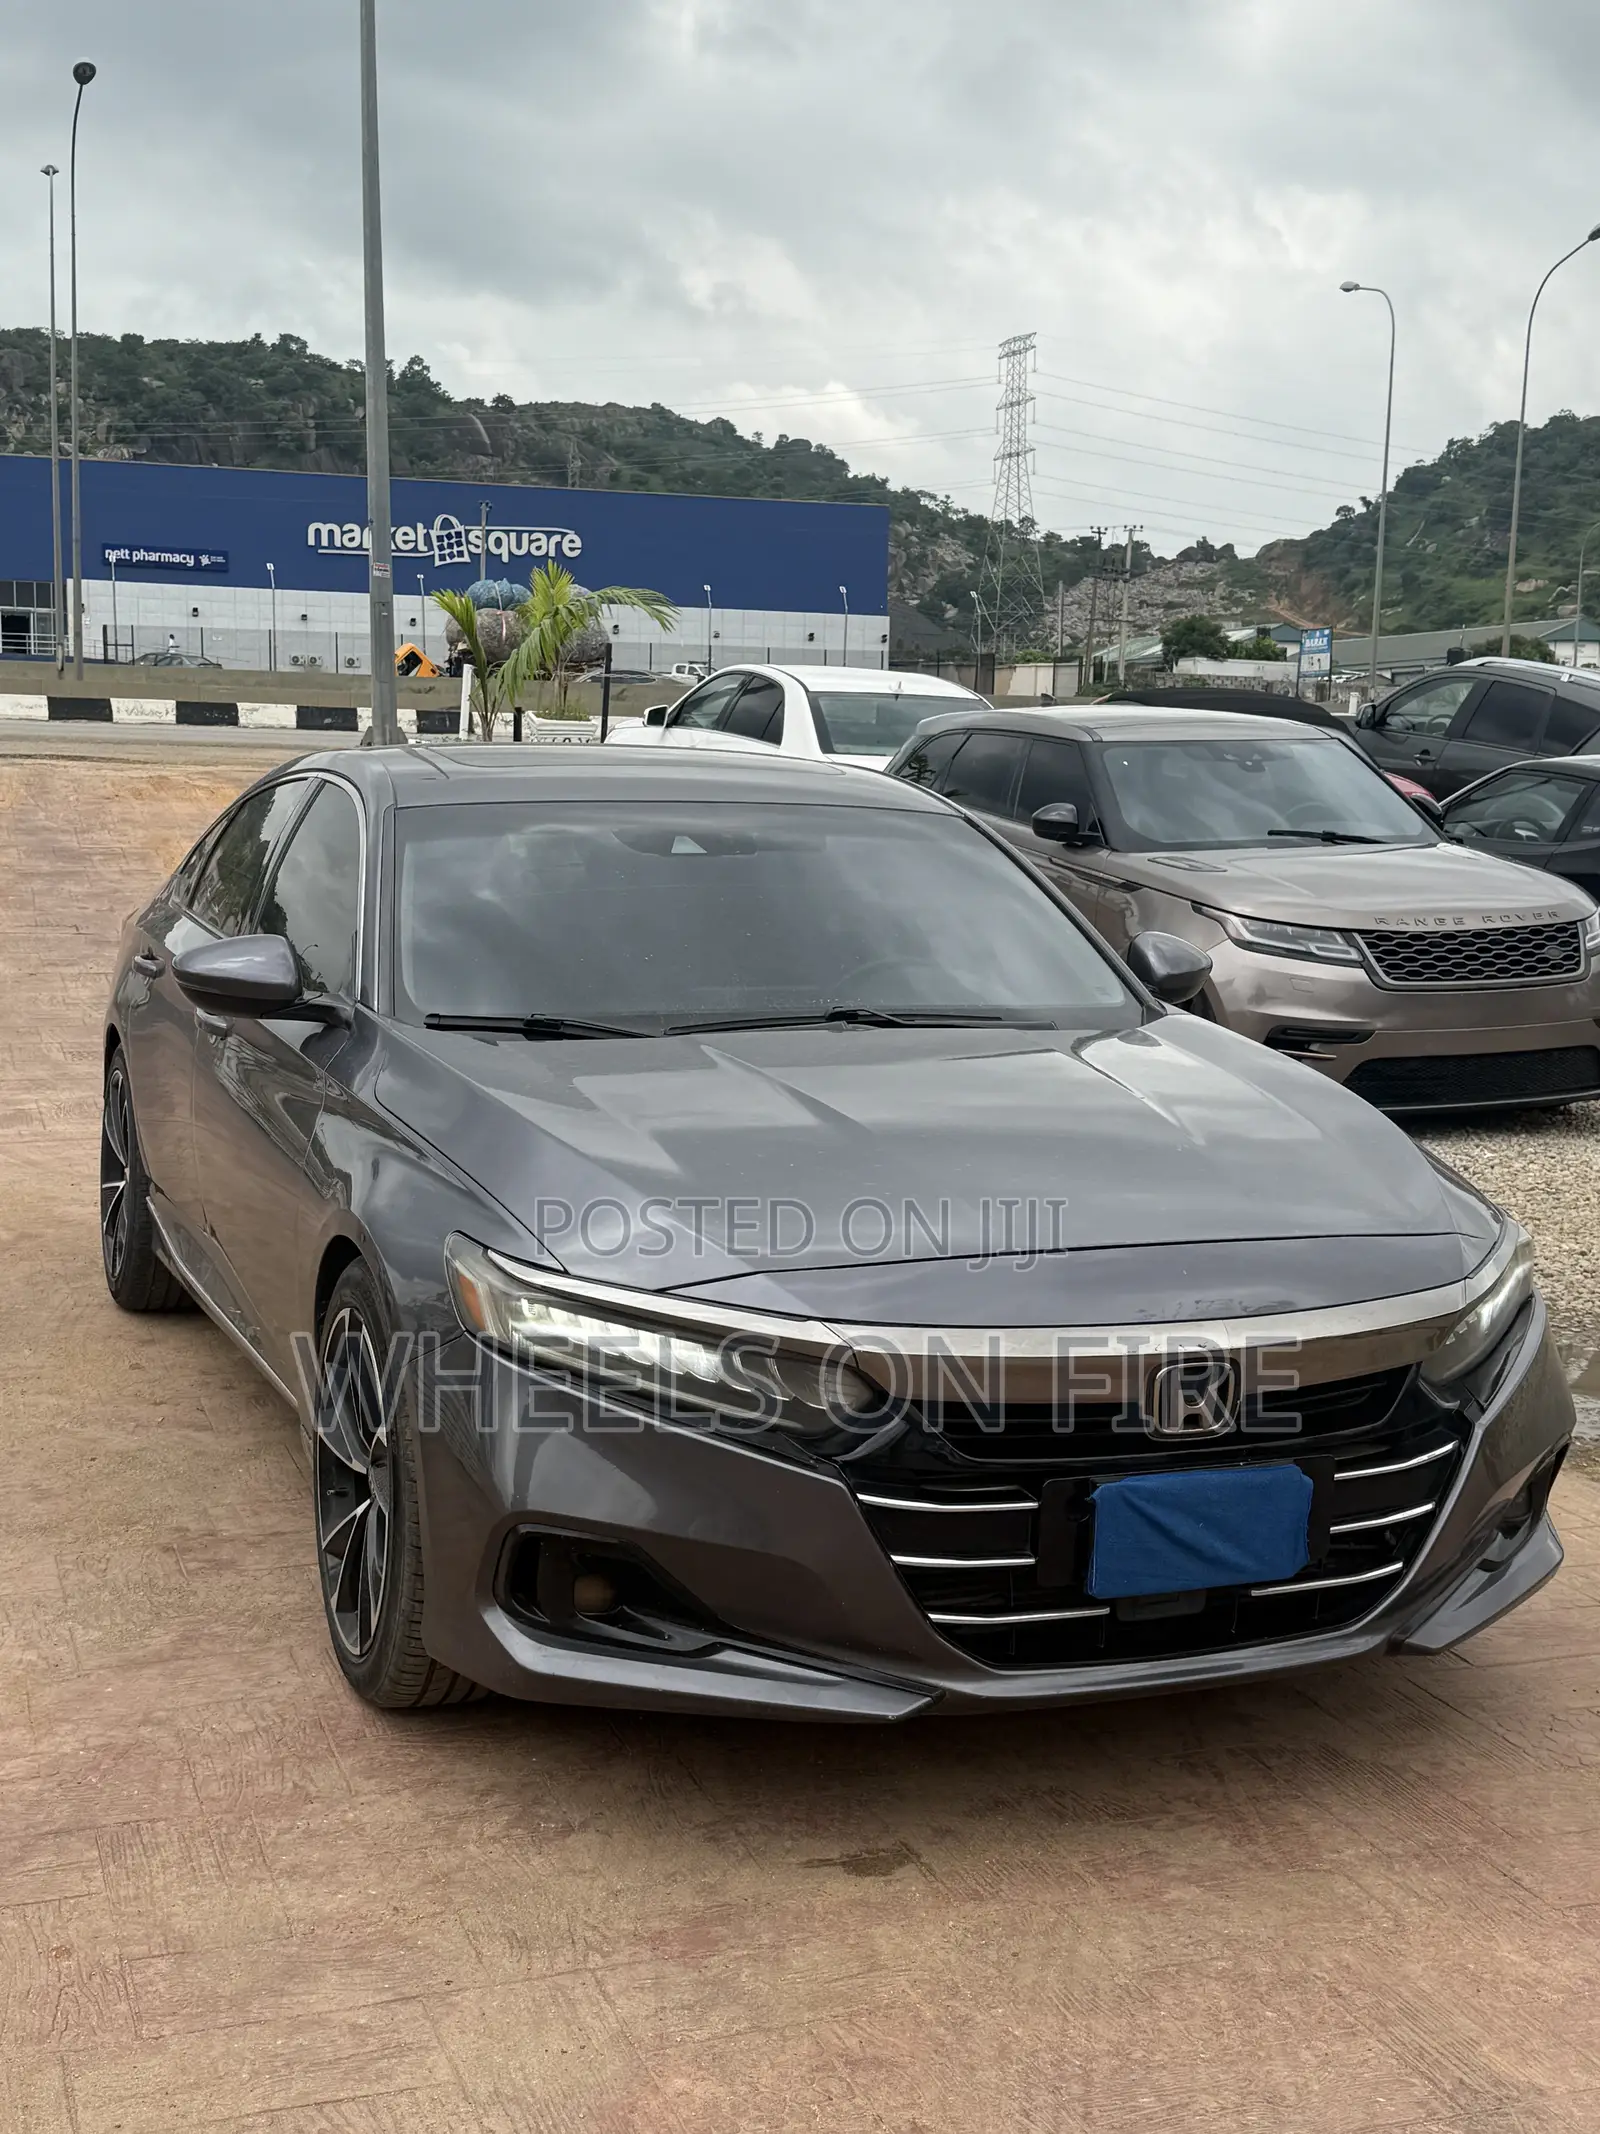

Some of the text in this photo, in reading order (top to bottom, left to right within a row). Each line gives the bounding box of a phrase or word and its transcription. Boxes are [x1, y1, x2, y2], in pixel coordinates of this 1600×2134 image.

[468, 529, 582, 563] square
[132, 549, 194, 567] pharmacy
[1374, 910, 1561, 926] RANGE ROVER
